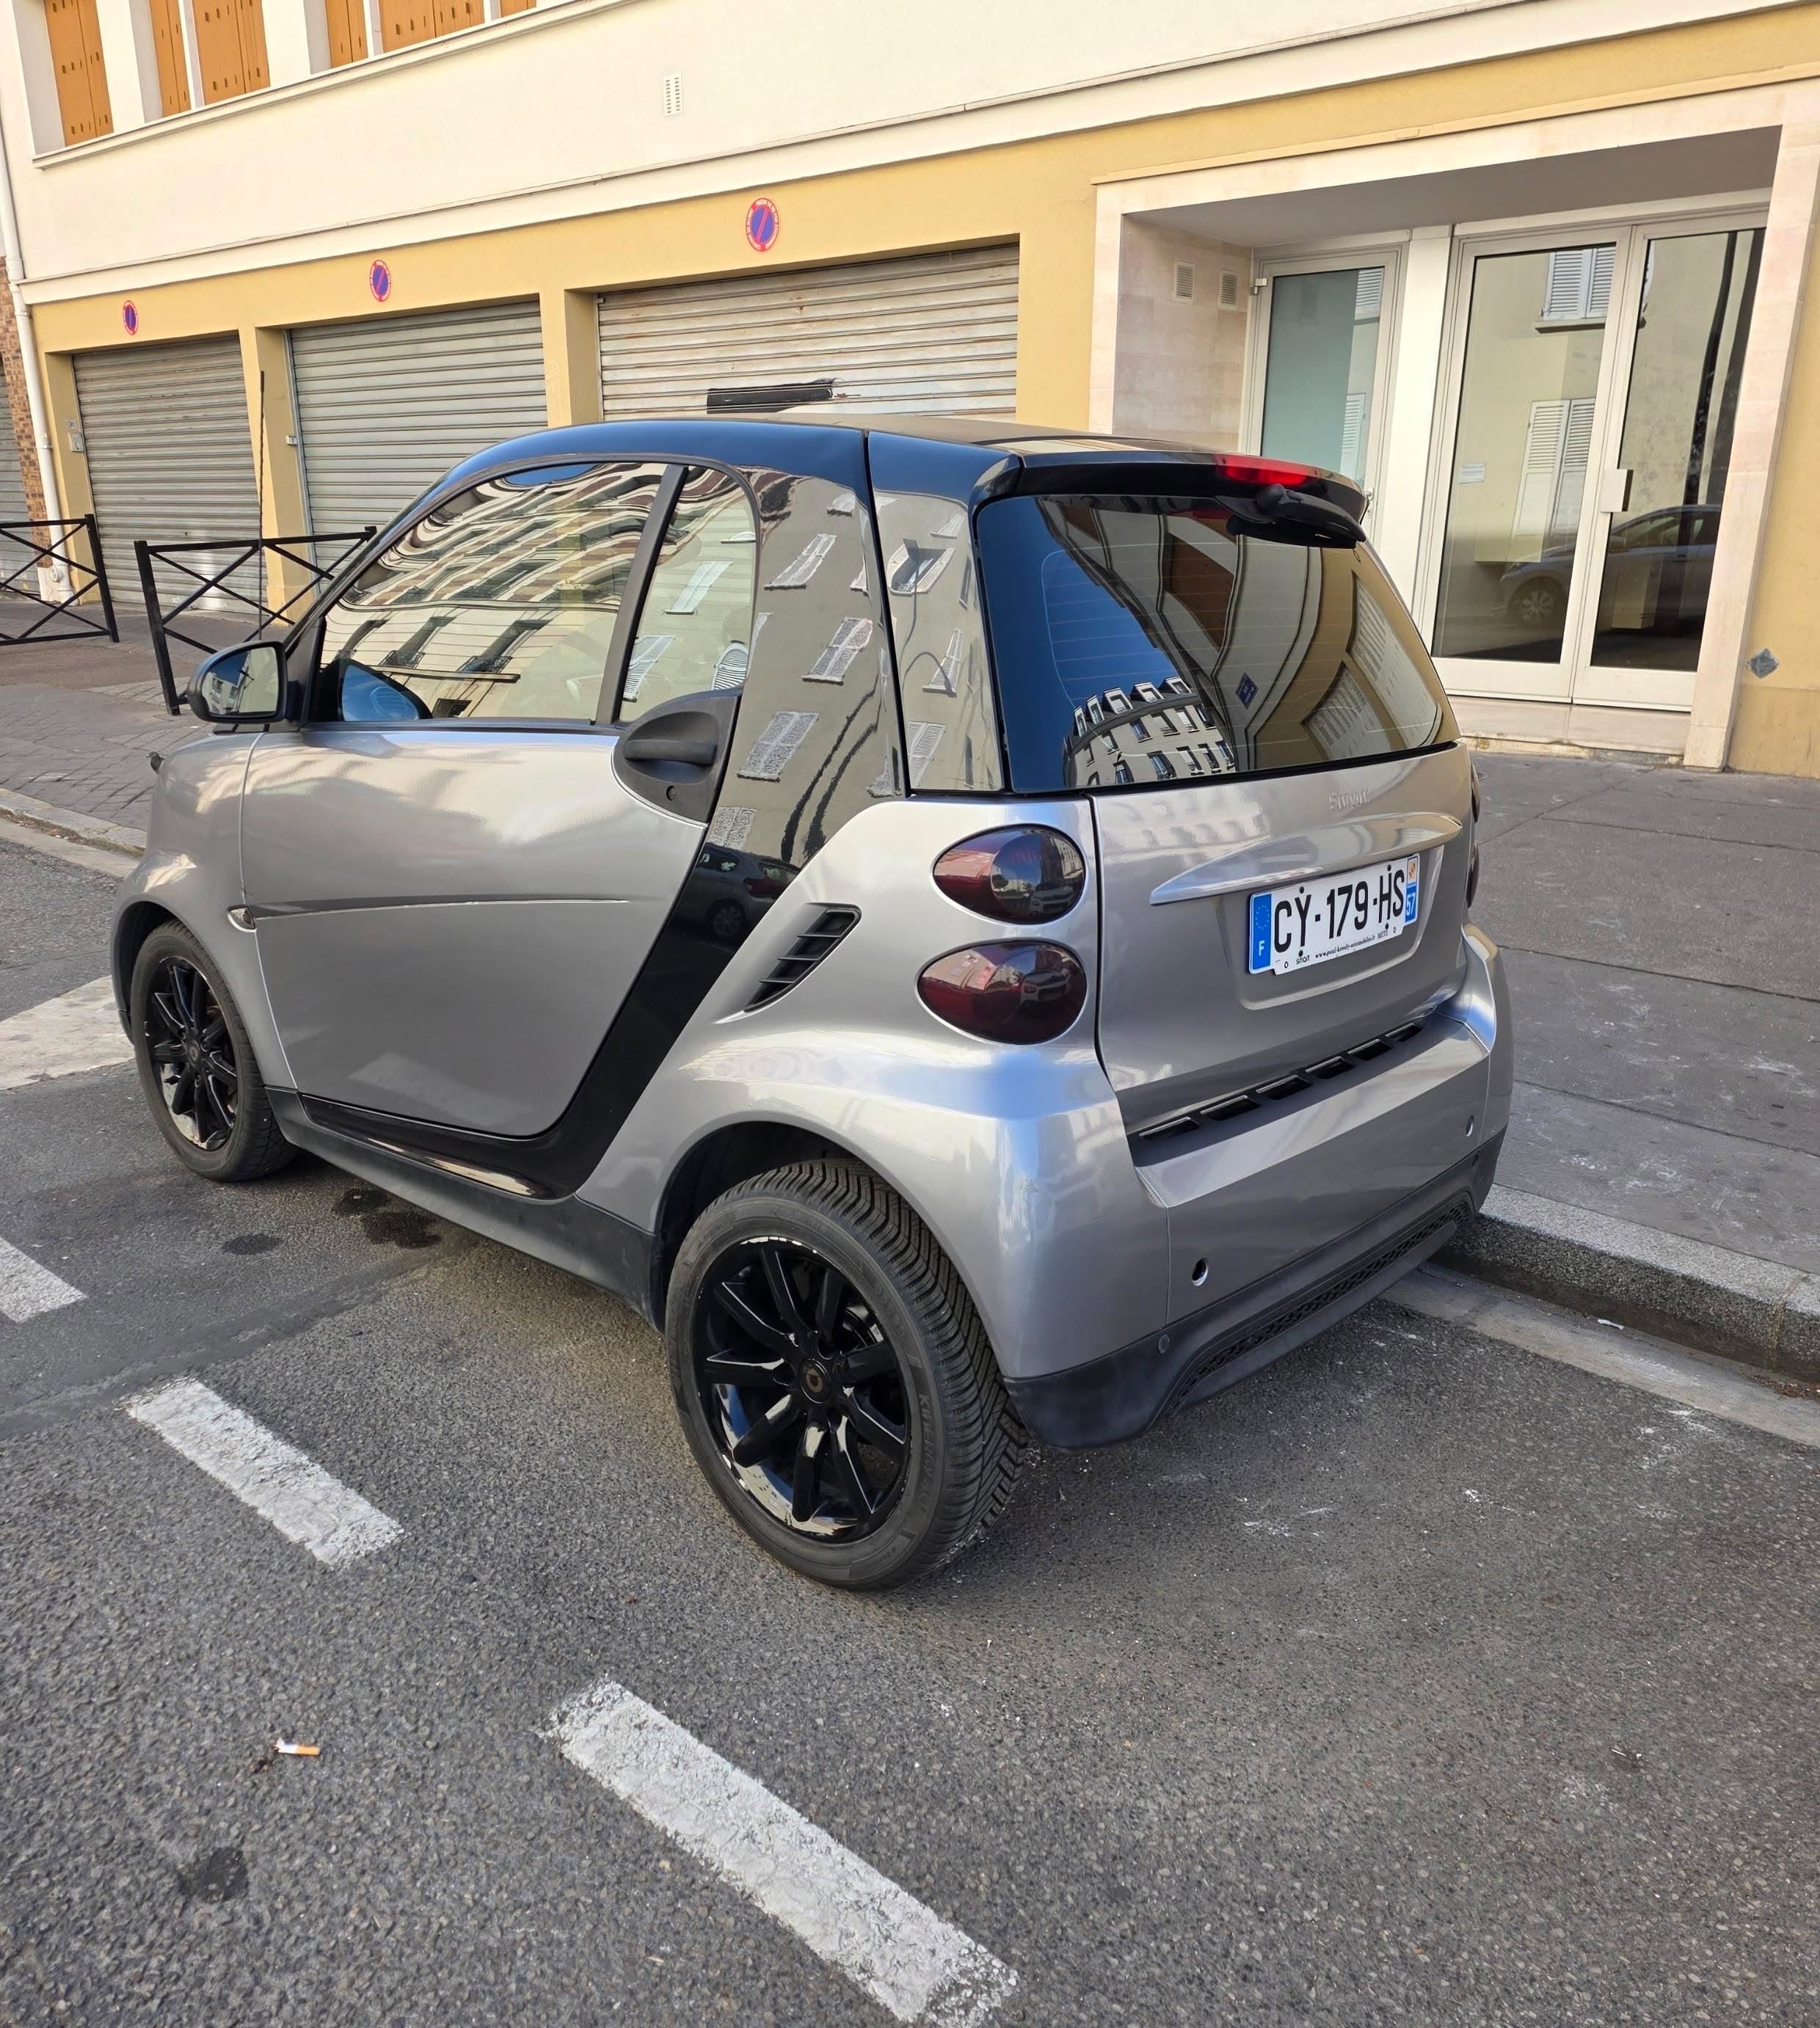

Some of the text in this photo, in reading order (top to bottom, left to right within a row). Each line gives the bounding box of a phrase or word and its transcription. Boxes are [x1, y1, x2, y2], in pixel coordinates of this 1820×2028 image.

[1274, 869, 1405, 953] CY-179-HS
[1406, 892, 1416, 916] 57
[1259, 940, 1265, 957] F
[1296, 955, 1310, 965] smart
[1377, 930, 1388, 940] METZ
